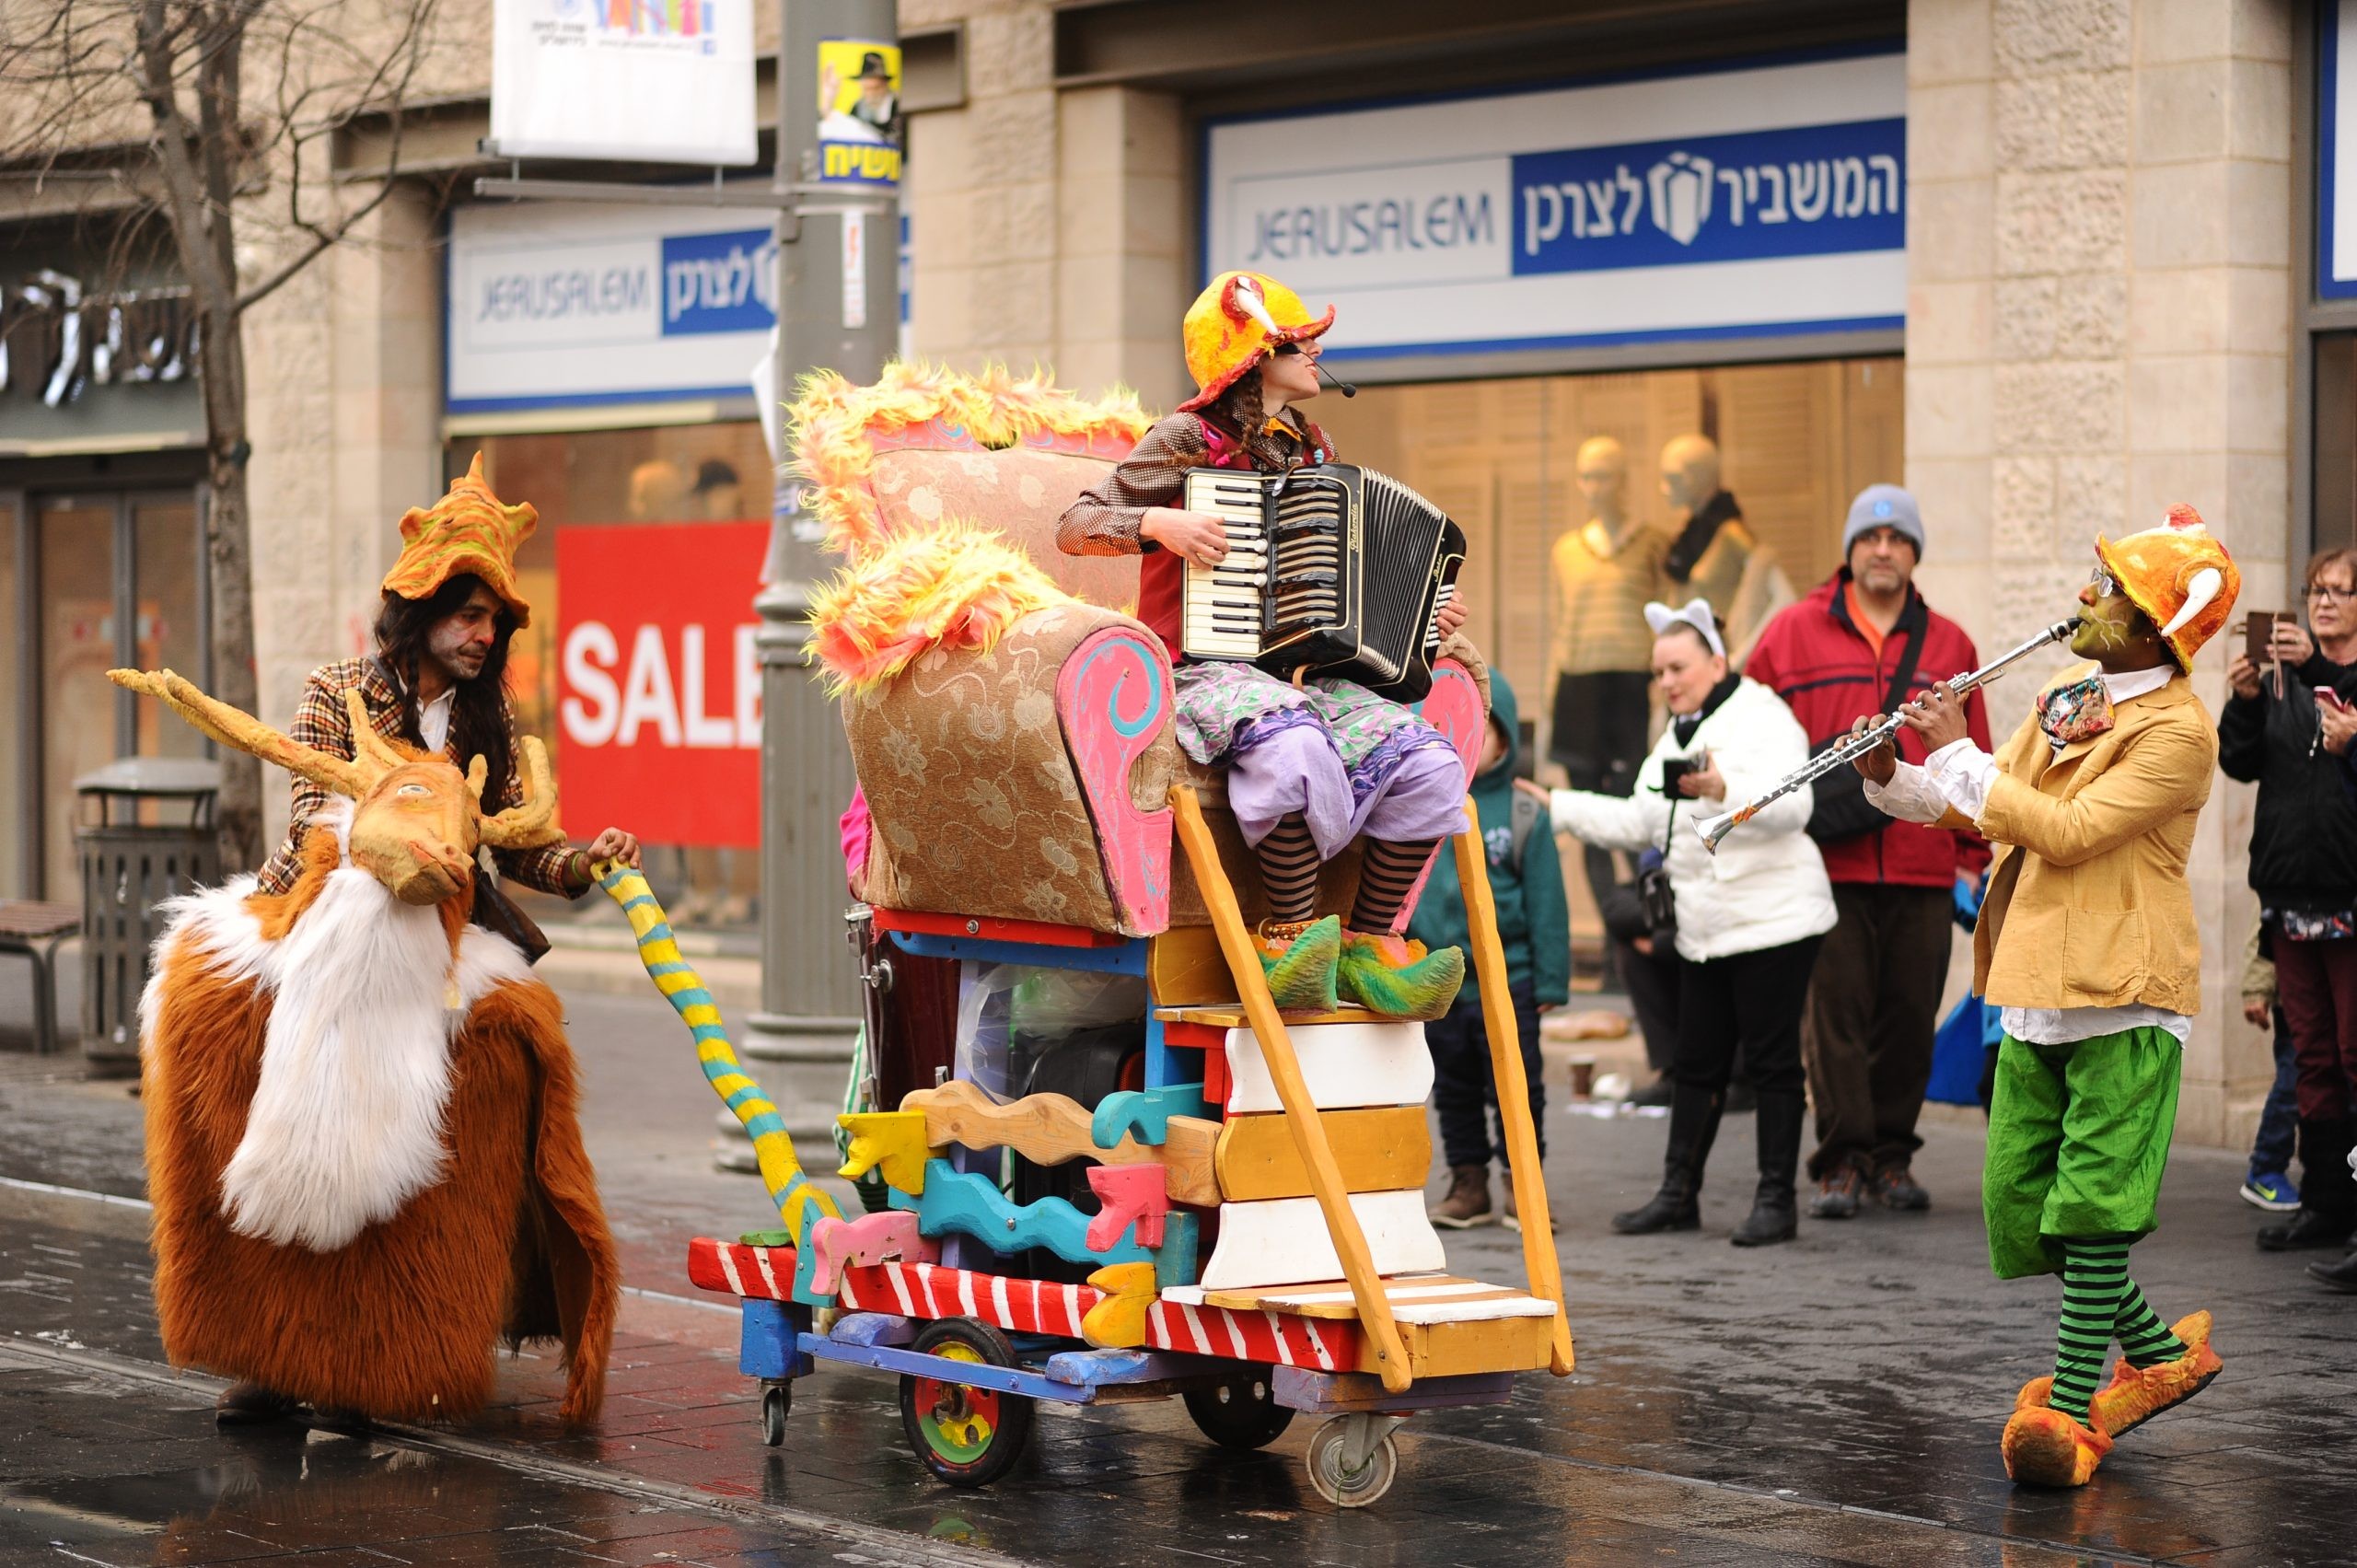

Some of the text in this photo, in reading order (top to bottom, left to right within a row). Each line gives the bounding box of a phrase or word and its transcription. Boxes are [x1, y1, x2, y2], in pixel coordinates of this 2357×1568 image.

[1247, 192, 1495, 262] JERUSALEM
[1523, 154, 1899, 257] המשביר לצרכן
[476, 266, 653, 324] JERUSALEM
